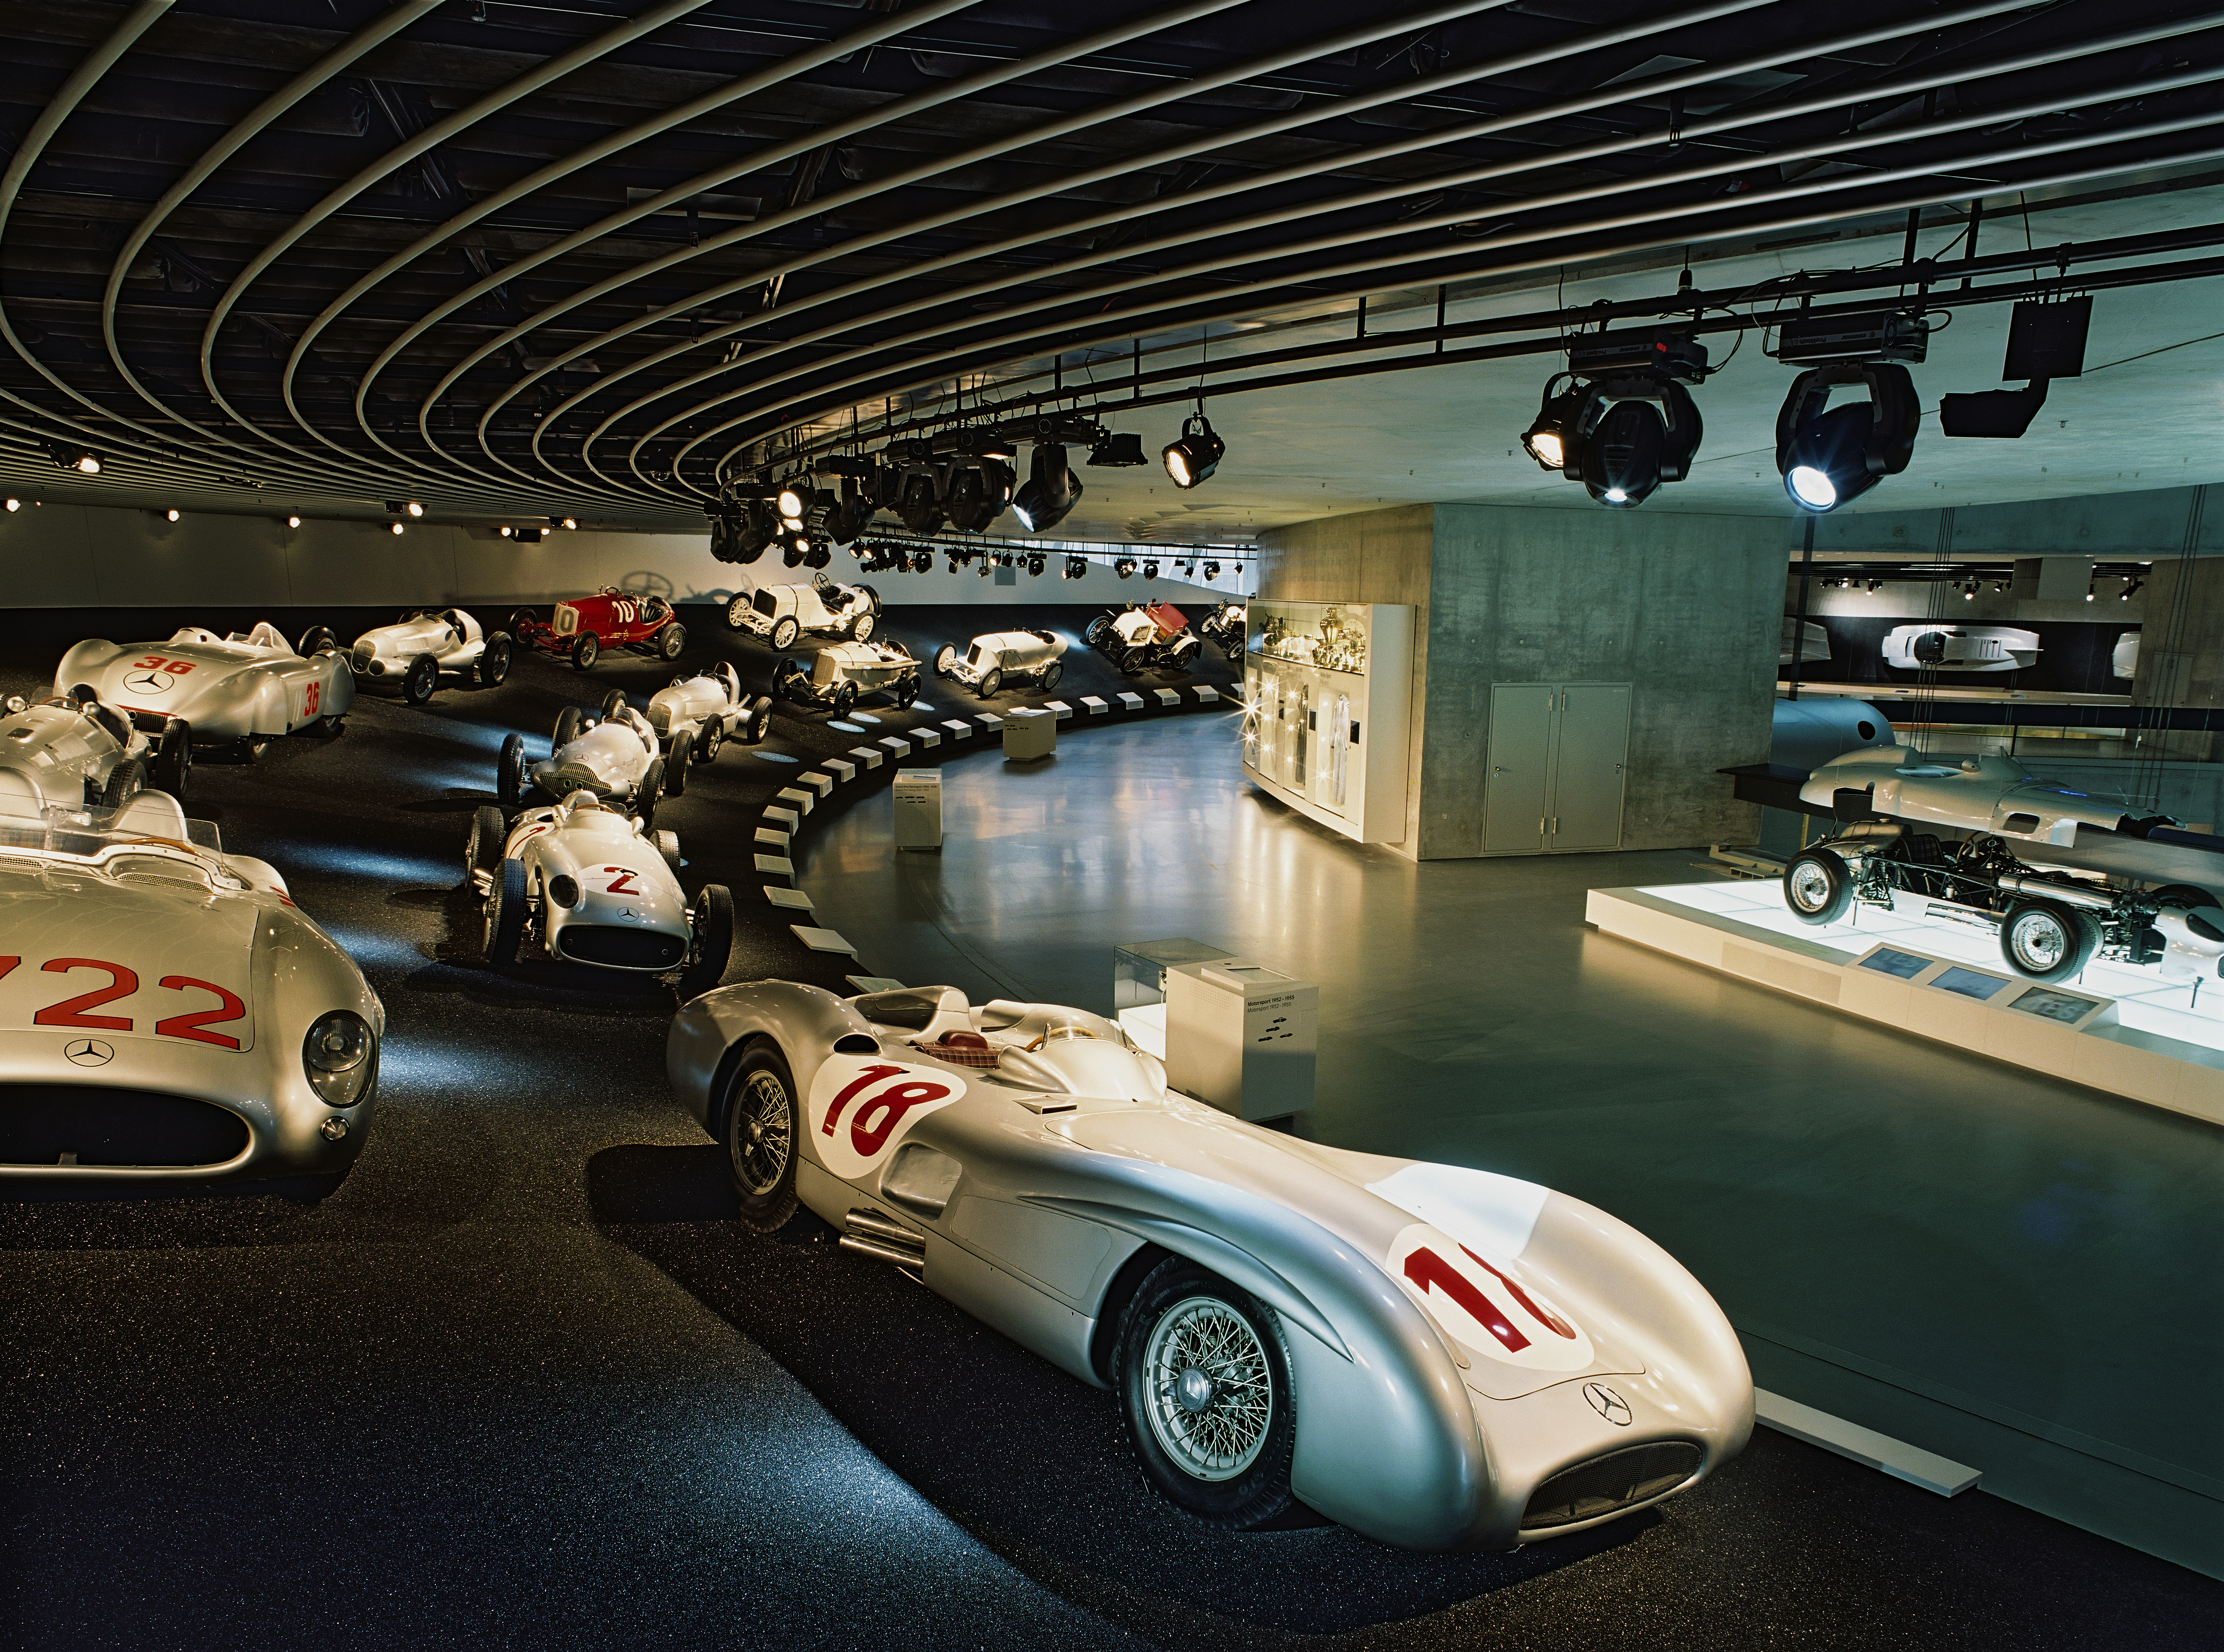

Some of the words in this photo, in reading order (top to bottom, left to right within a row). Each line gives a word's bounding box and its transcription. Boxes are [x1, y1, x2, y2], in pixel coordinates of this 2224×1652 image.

[612, 600, 634, 623] 10
[133, 656, 197, 675] 36
[303, 682, 320, 717] 36
[603, 866, 640, 896] 2
[0, 956, 246, 1050] 22
[821, 1065, 951, 1157] 18
